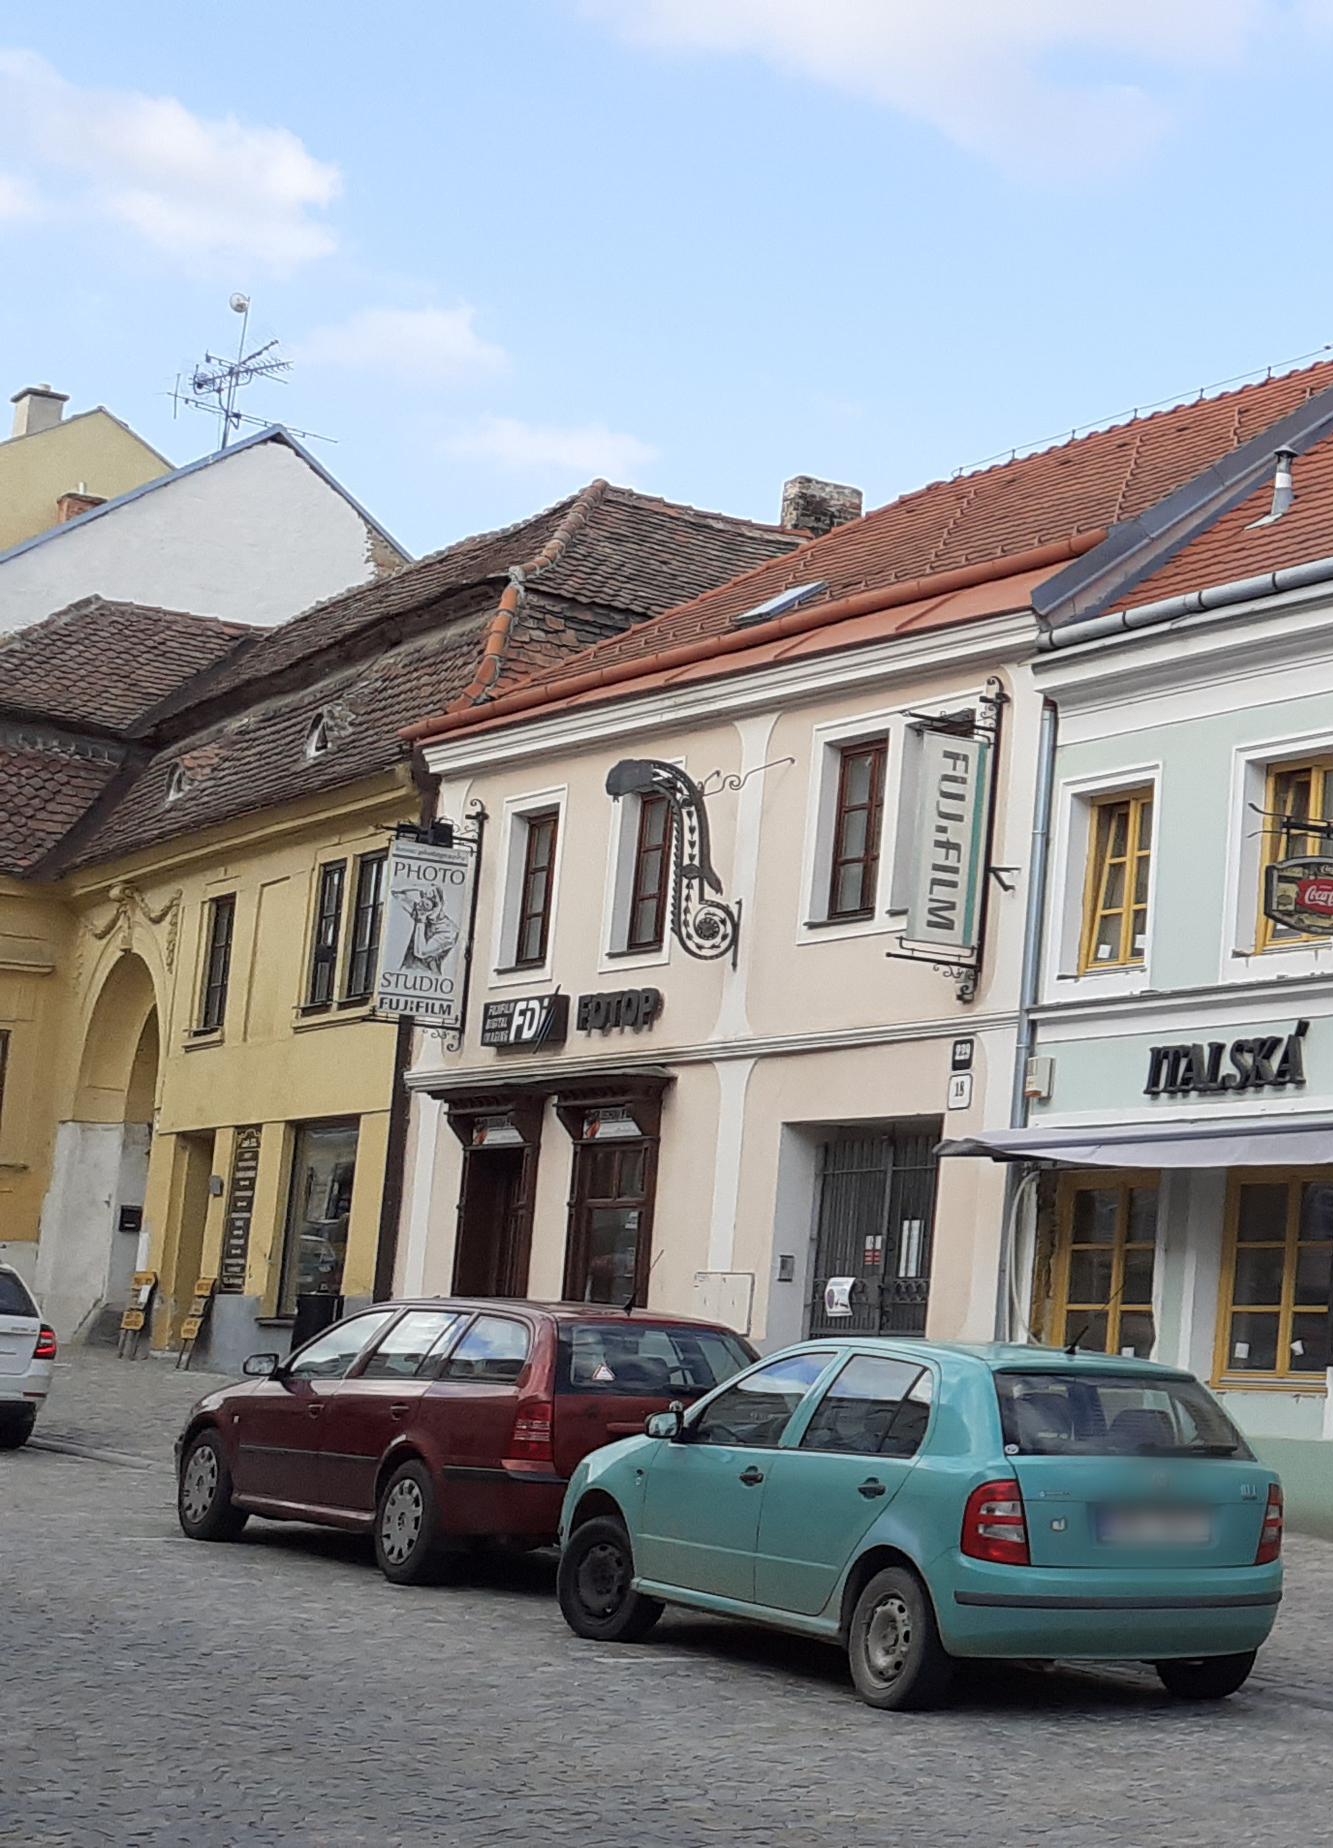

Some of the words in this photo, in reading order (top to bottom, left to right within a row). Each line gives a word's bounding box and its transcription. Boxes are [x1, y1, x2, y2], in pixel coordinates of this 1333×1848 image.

[926, 750, 970, 931] FUJIFILM
[394, 862, 466, 886] PHOTO
[381, 972, 454, 994] STUDIO
[379, 997, 452, 1016] FUJIFILM
[1143, 1020, 1311, 1095] ITALSKÁ
